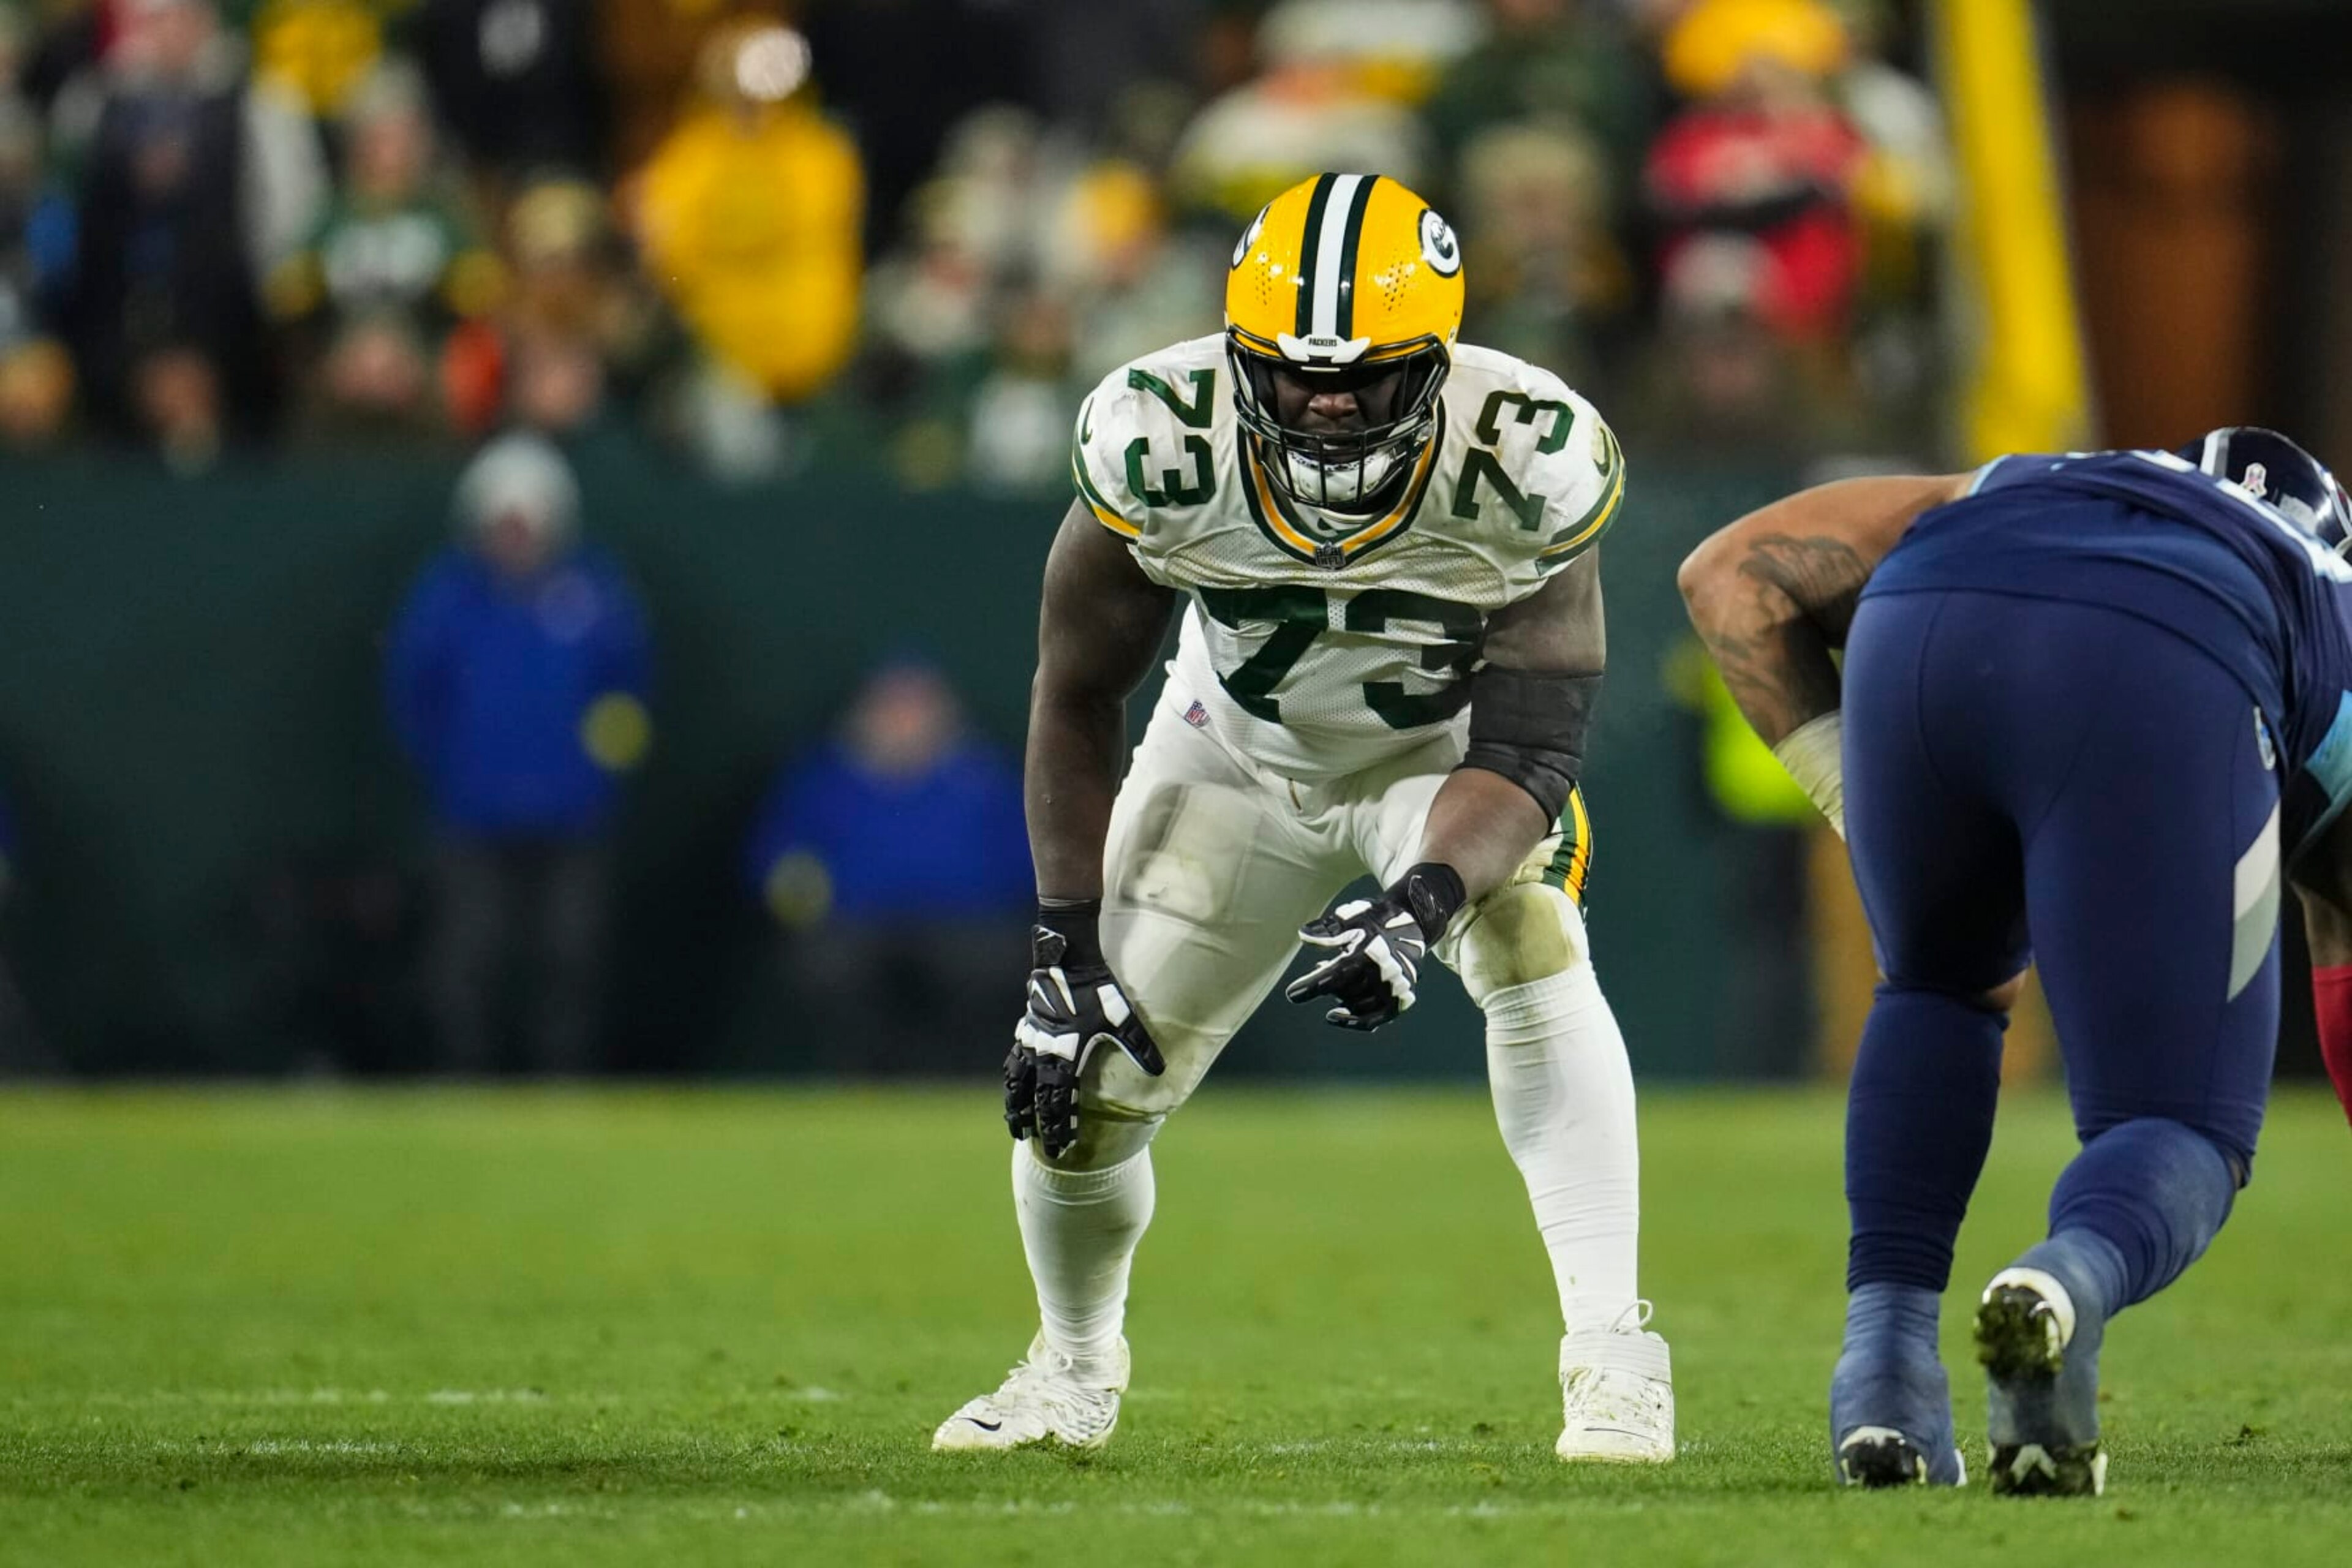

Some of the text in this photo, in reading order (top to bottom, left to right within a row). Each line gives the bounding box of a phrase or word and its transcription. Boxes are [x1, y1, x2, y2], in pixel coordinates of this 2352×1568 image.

[1308, 338, 1337, 347] PACKERS
[1125, 368, 1216, 507] 73
[1452, 390, 1575, 532] 73
[1197, 584, 1485, 729] 73
